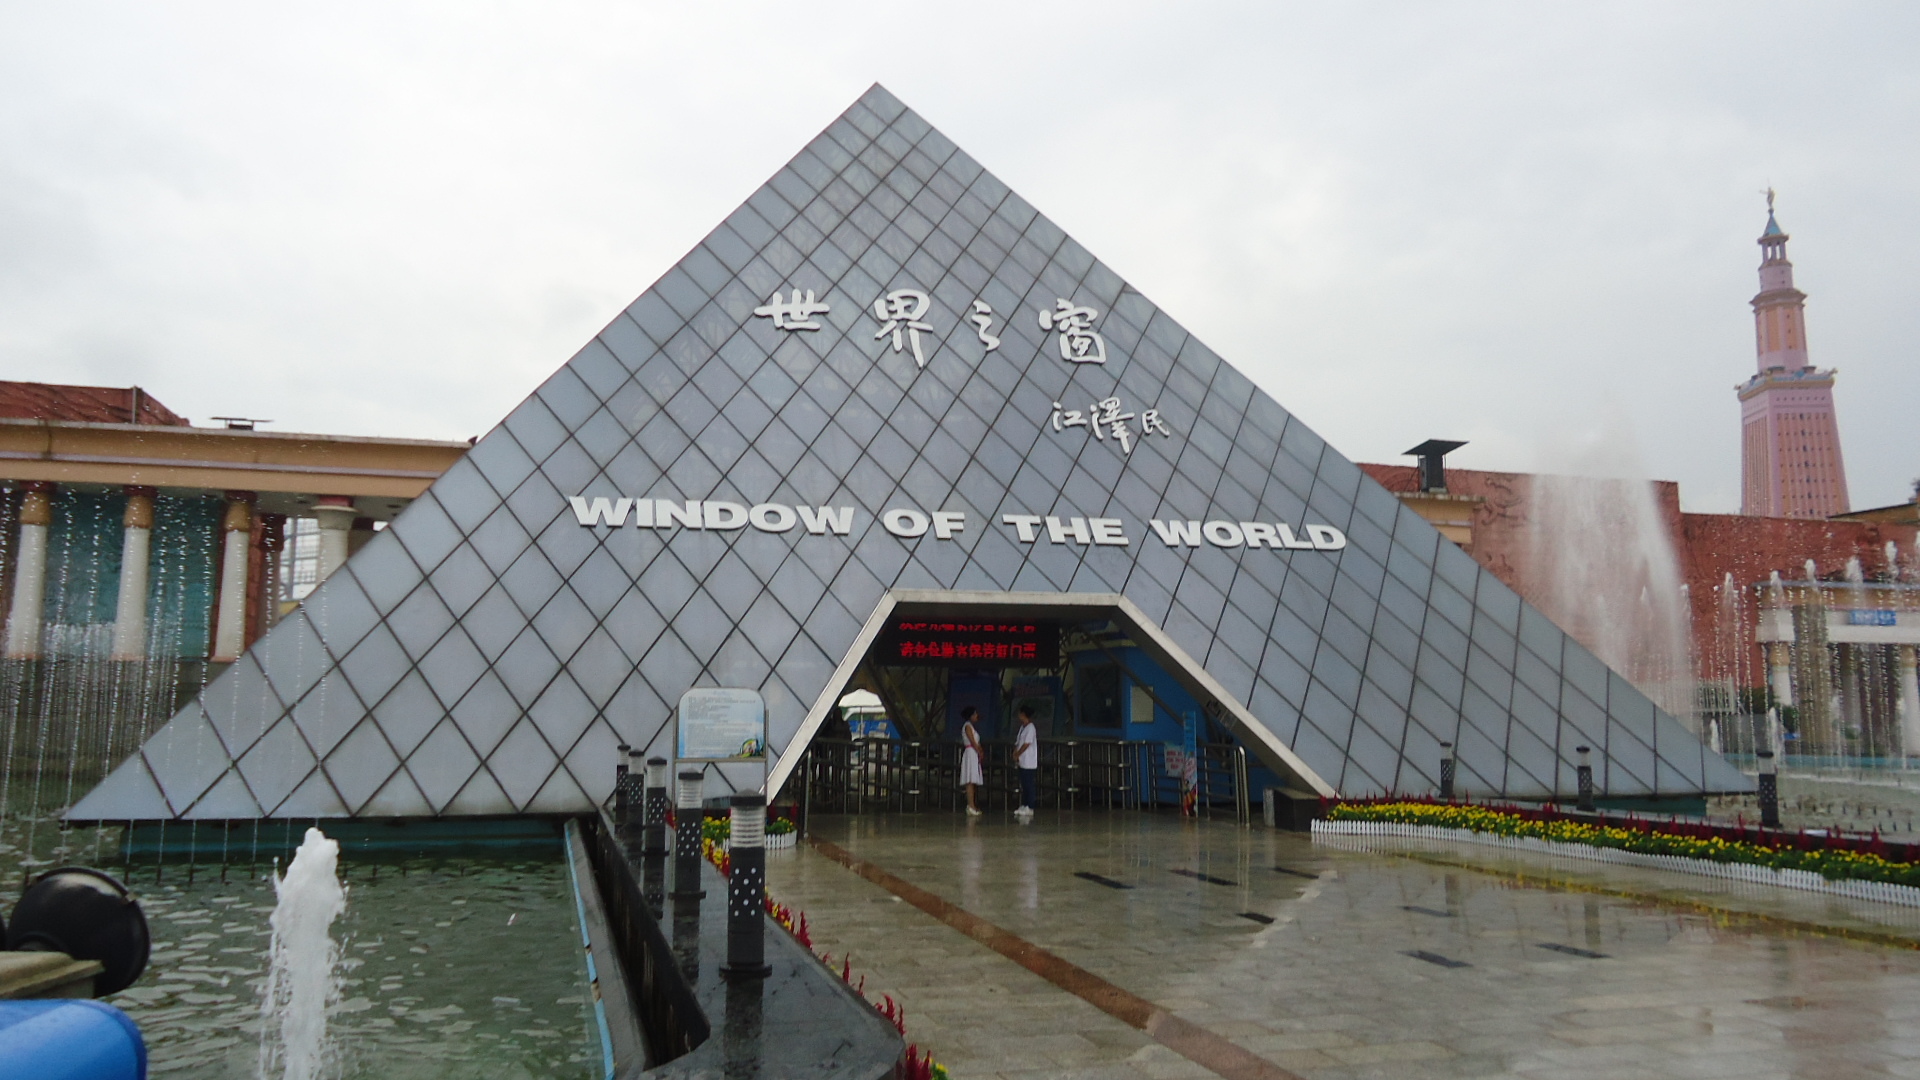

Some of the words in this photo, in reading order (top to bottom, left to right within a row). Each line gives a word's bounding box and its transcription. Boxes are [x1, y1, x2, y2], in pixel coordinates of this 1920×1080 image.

[754, 288, 1106, 369] 世界之窗
[569, 496, 855, 535] WINDOW
[883, 508, 965, 539] OF
[1002, 514, 1129, 547] THE
[1149, 519, 1347, 551] WORLD
